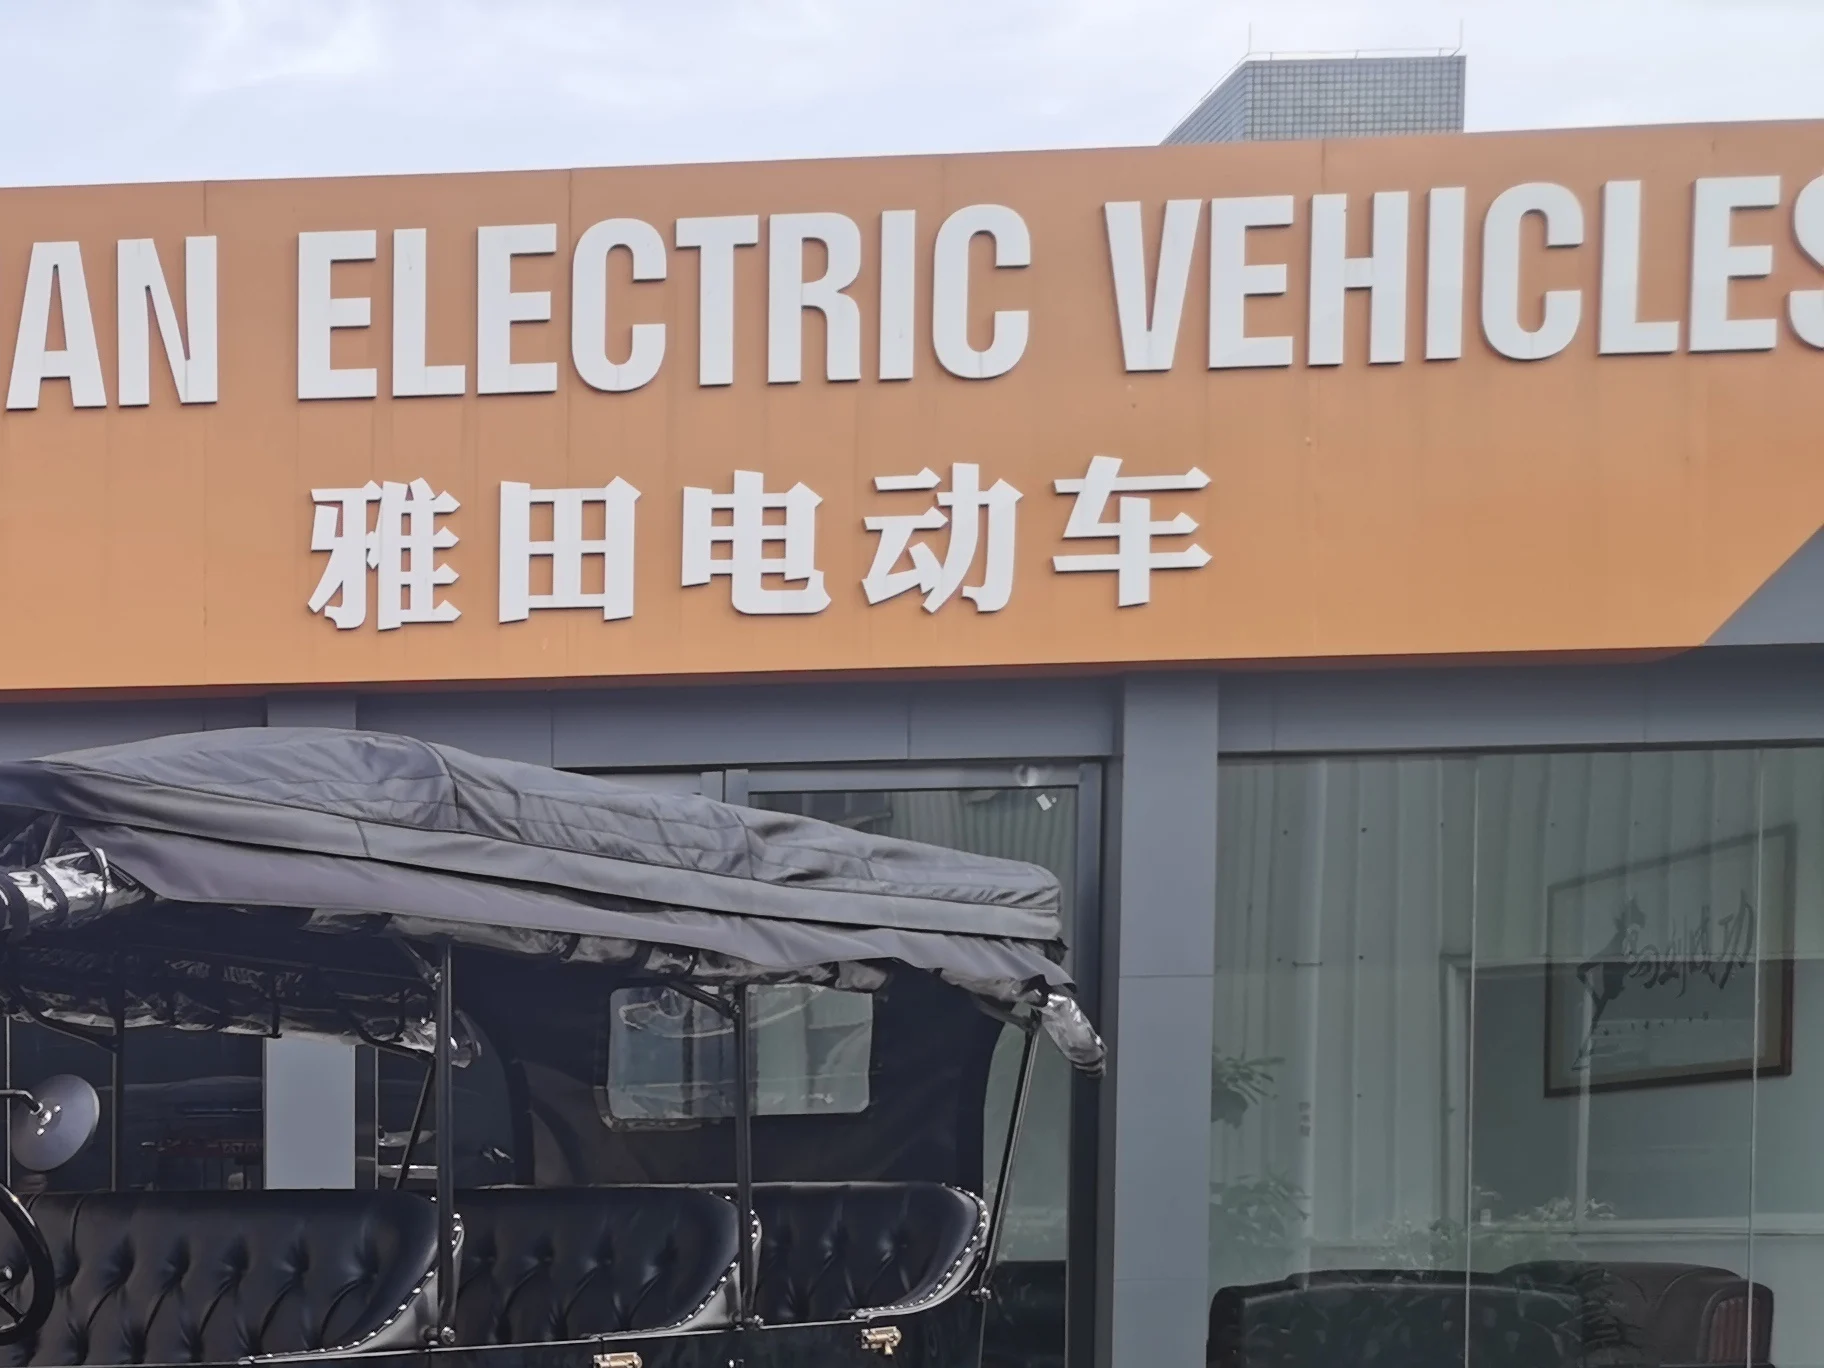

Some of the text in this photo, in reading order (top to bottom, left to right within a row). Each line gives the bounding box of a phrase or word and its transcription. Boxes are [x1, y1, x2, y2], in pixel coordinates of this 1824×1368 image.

[296, 203, 1032, 400] ELECTRIC
[307, 455, 1213, 631] 雅田电动车
